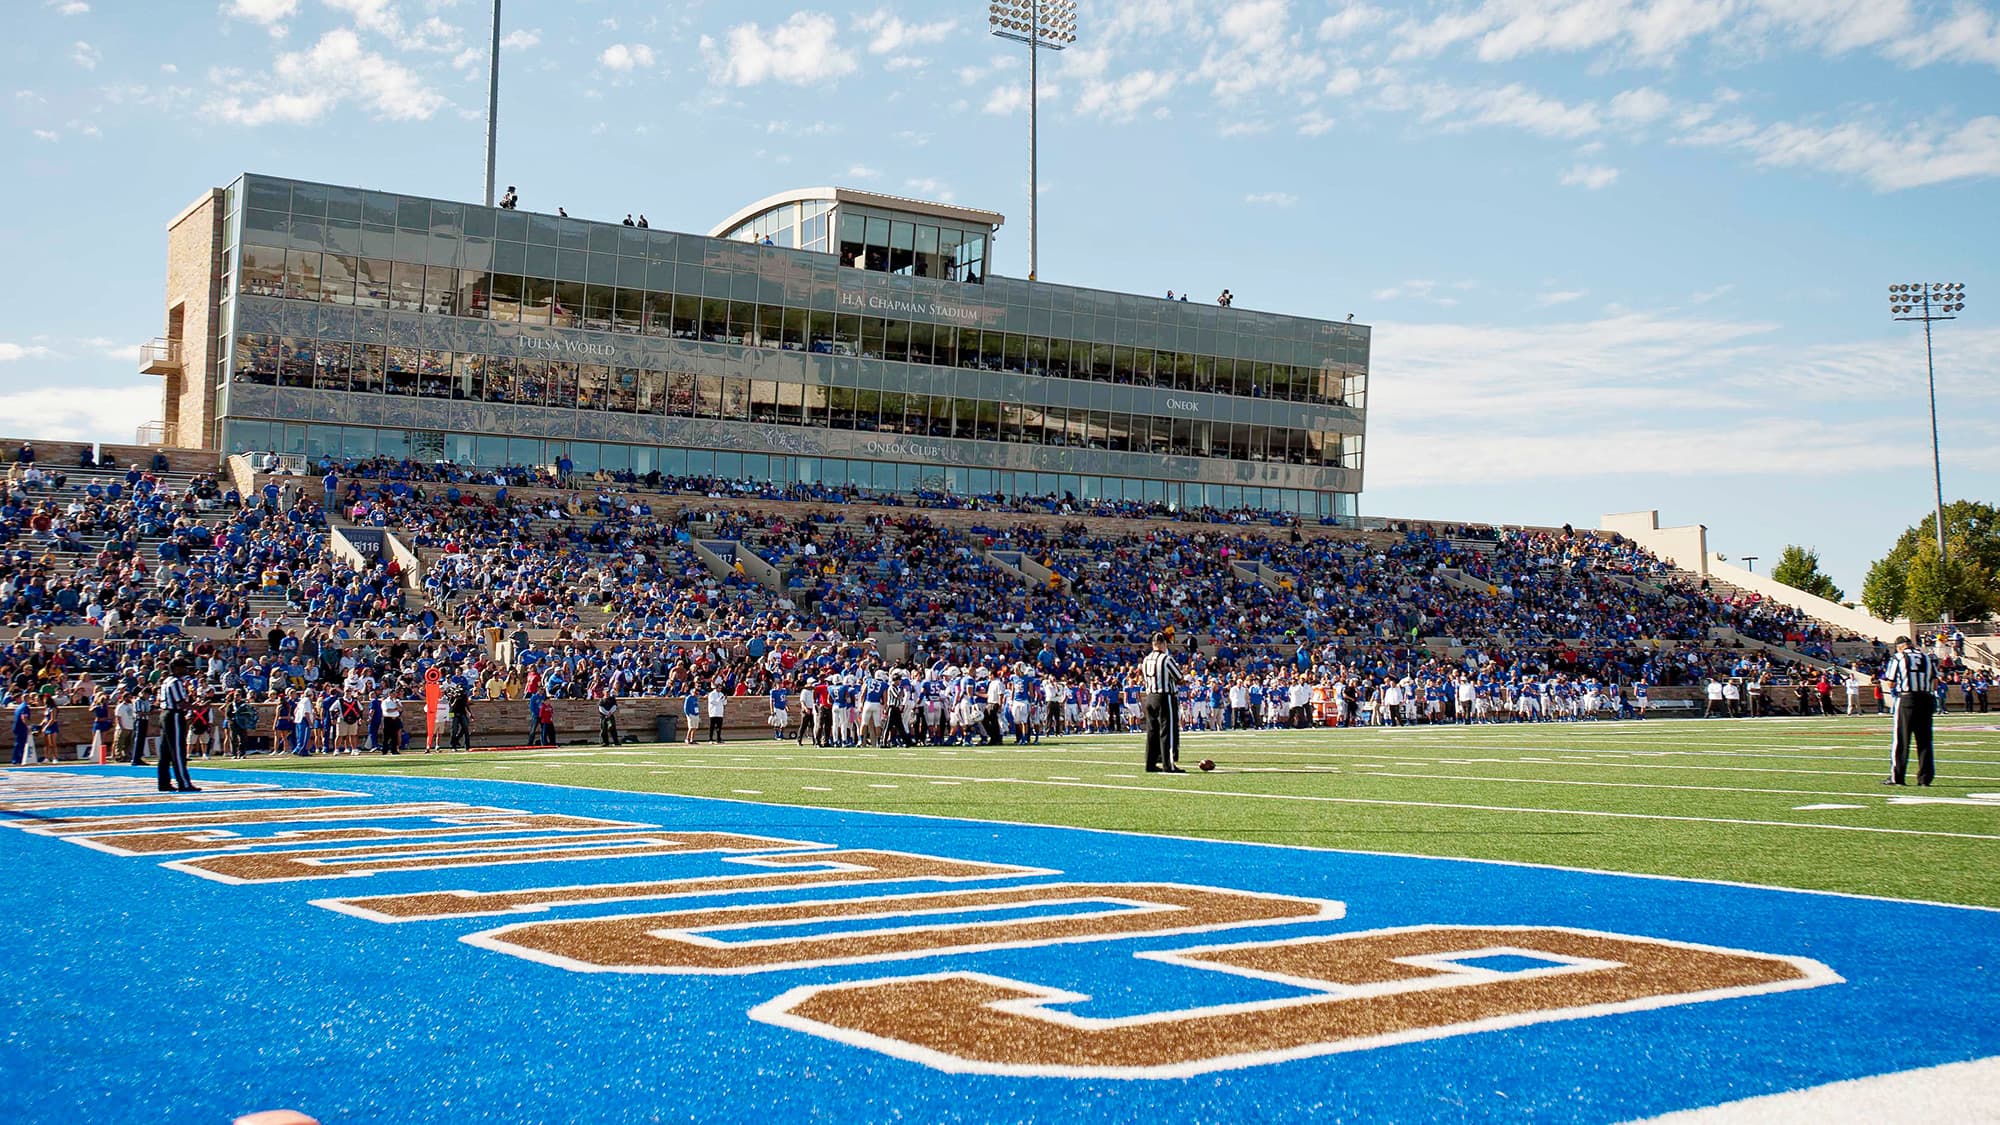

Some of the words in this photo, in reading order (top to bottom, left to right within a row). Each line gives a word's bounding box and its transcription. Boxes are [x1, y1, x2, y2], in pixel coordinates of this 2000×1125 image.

[842, 293, 866, 307] H.A.
[869, 296, 926, 313] CHAPMAN
[929, 303, 978, 320] STADIUM
[517, 334, 560, 350] TULSA
[565, 339, 615, 356] WORLD
[1166, 398, 1199, 412] ONEOK
[867, 440, 907, 455] ONEOK
[910, 444, 938, 457] CLUB
[870, 680, 882, 693] 53
[930, 683, 940, 694] 55
